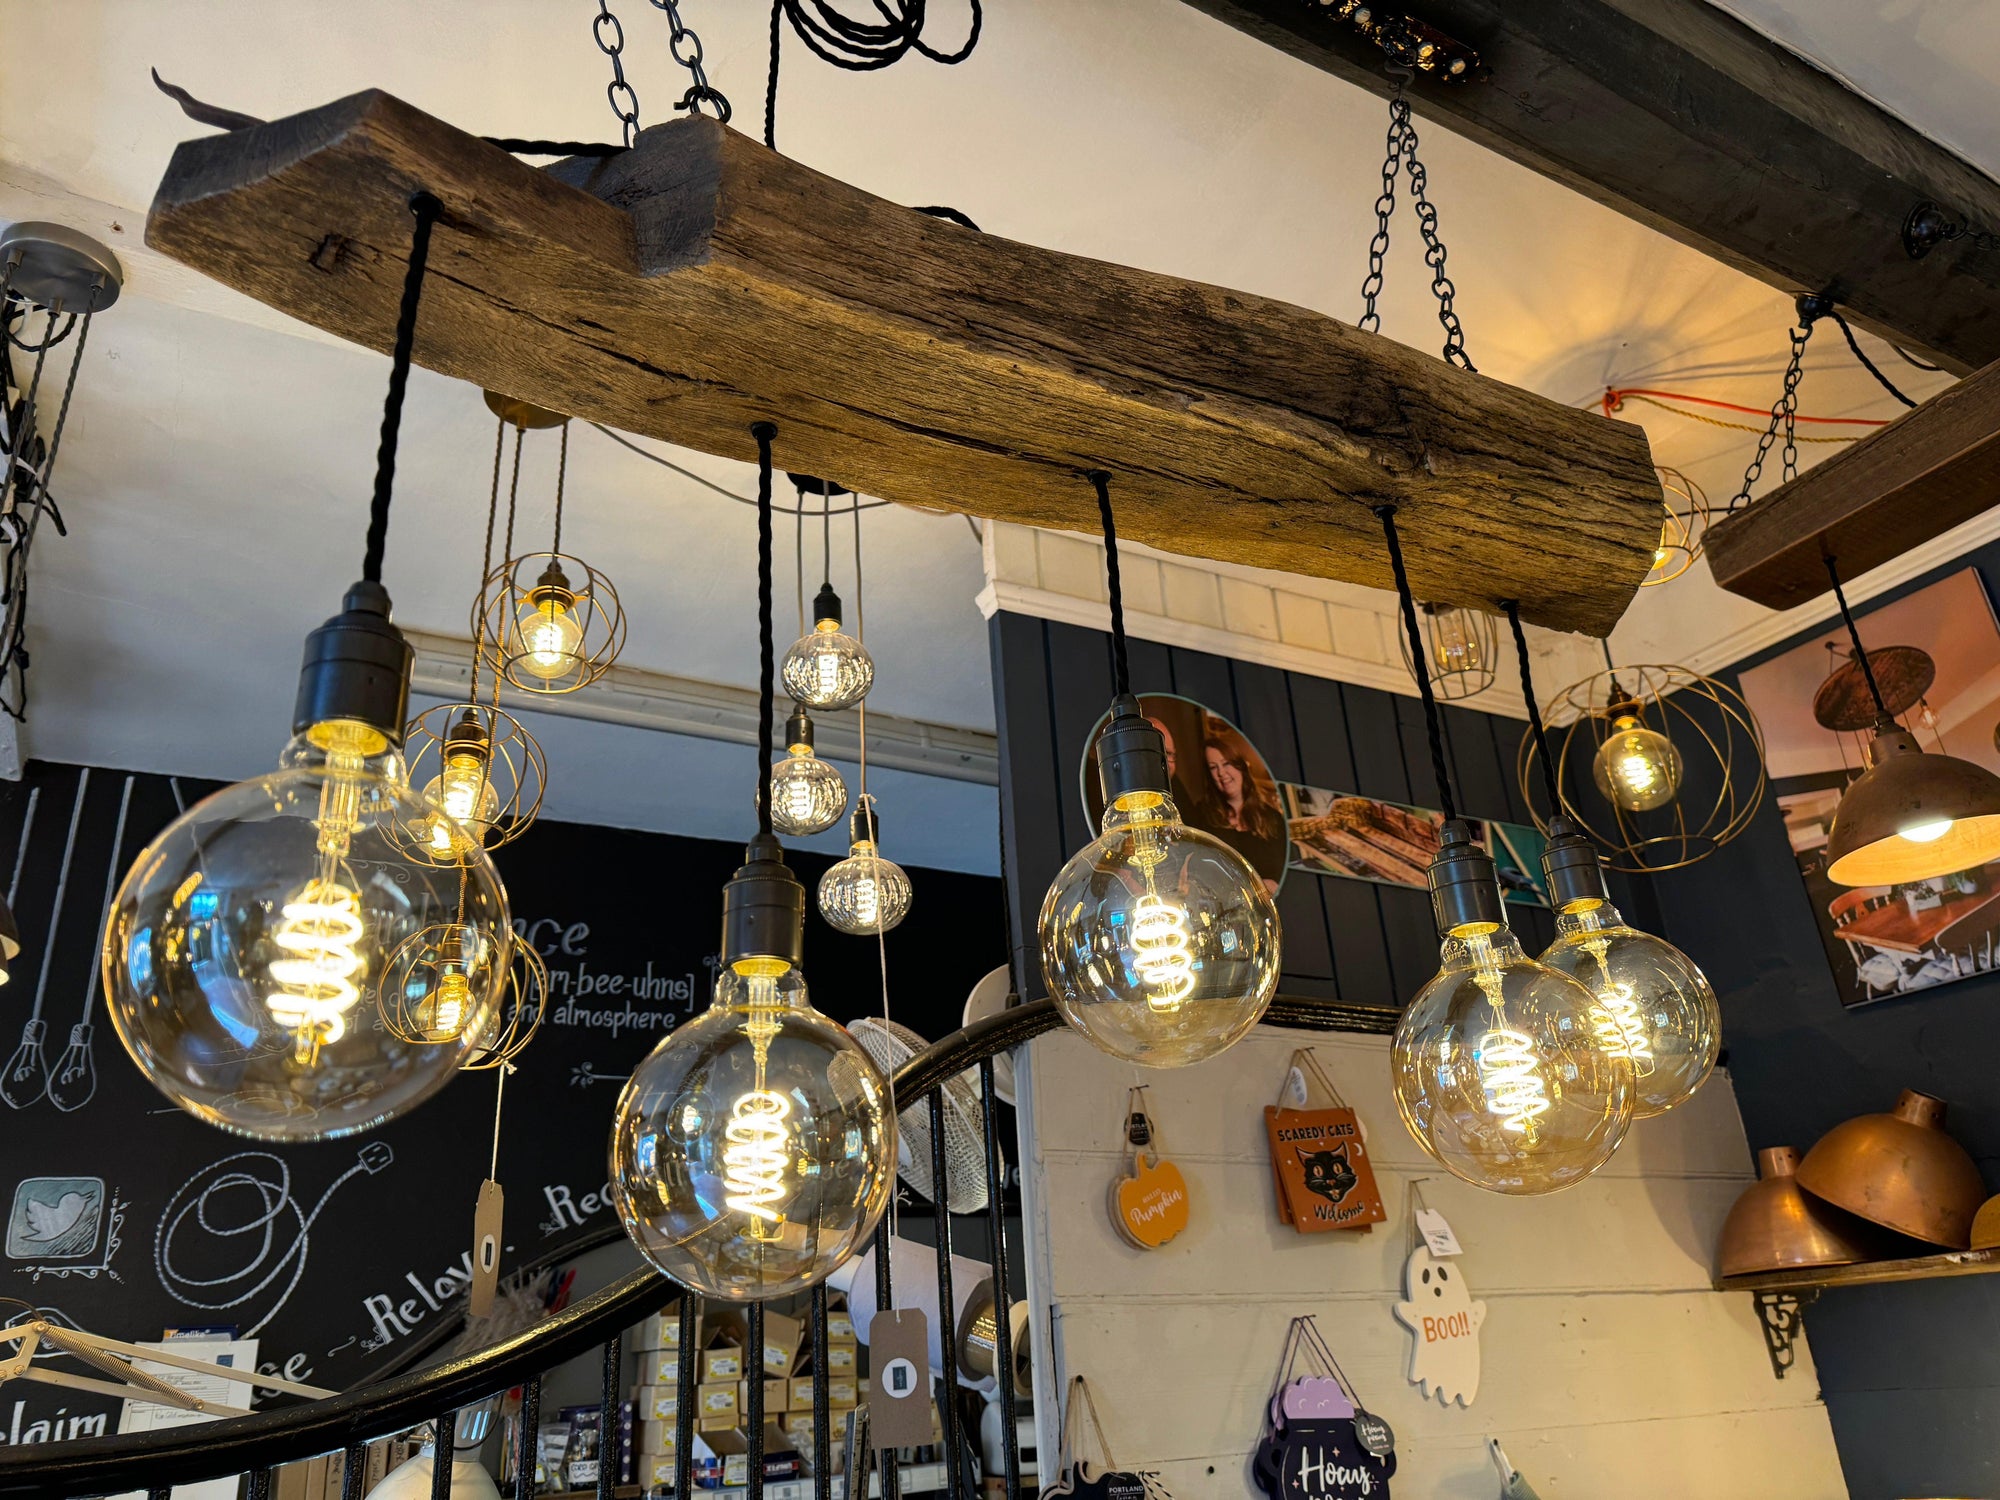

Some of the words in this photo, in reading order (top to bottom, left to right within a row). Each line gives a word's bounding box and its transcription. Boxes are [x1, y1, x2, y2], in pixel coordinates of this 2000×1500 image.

[553, 995, 676, 1039] atmosphere
[1277, 1125, 1326, 1142] SCAREDY
[1328, 1123, 1355, 1138] CATS
[1130, 1189, 1182, 1226] Pumpkin
[1422, 1311, 1471, 1343] BOO!!
[0, 1400, 107, 1446] laim
[1298, 1444, 1371, 1496] Hocus
[1108, 1485, 1144, 1495] PORTLAND
